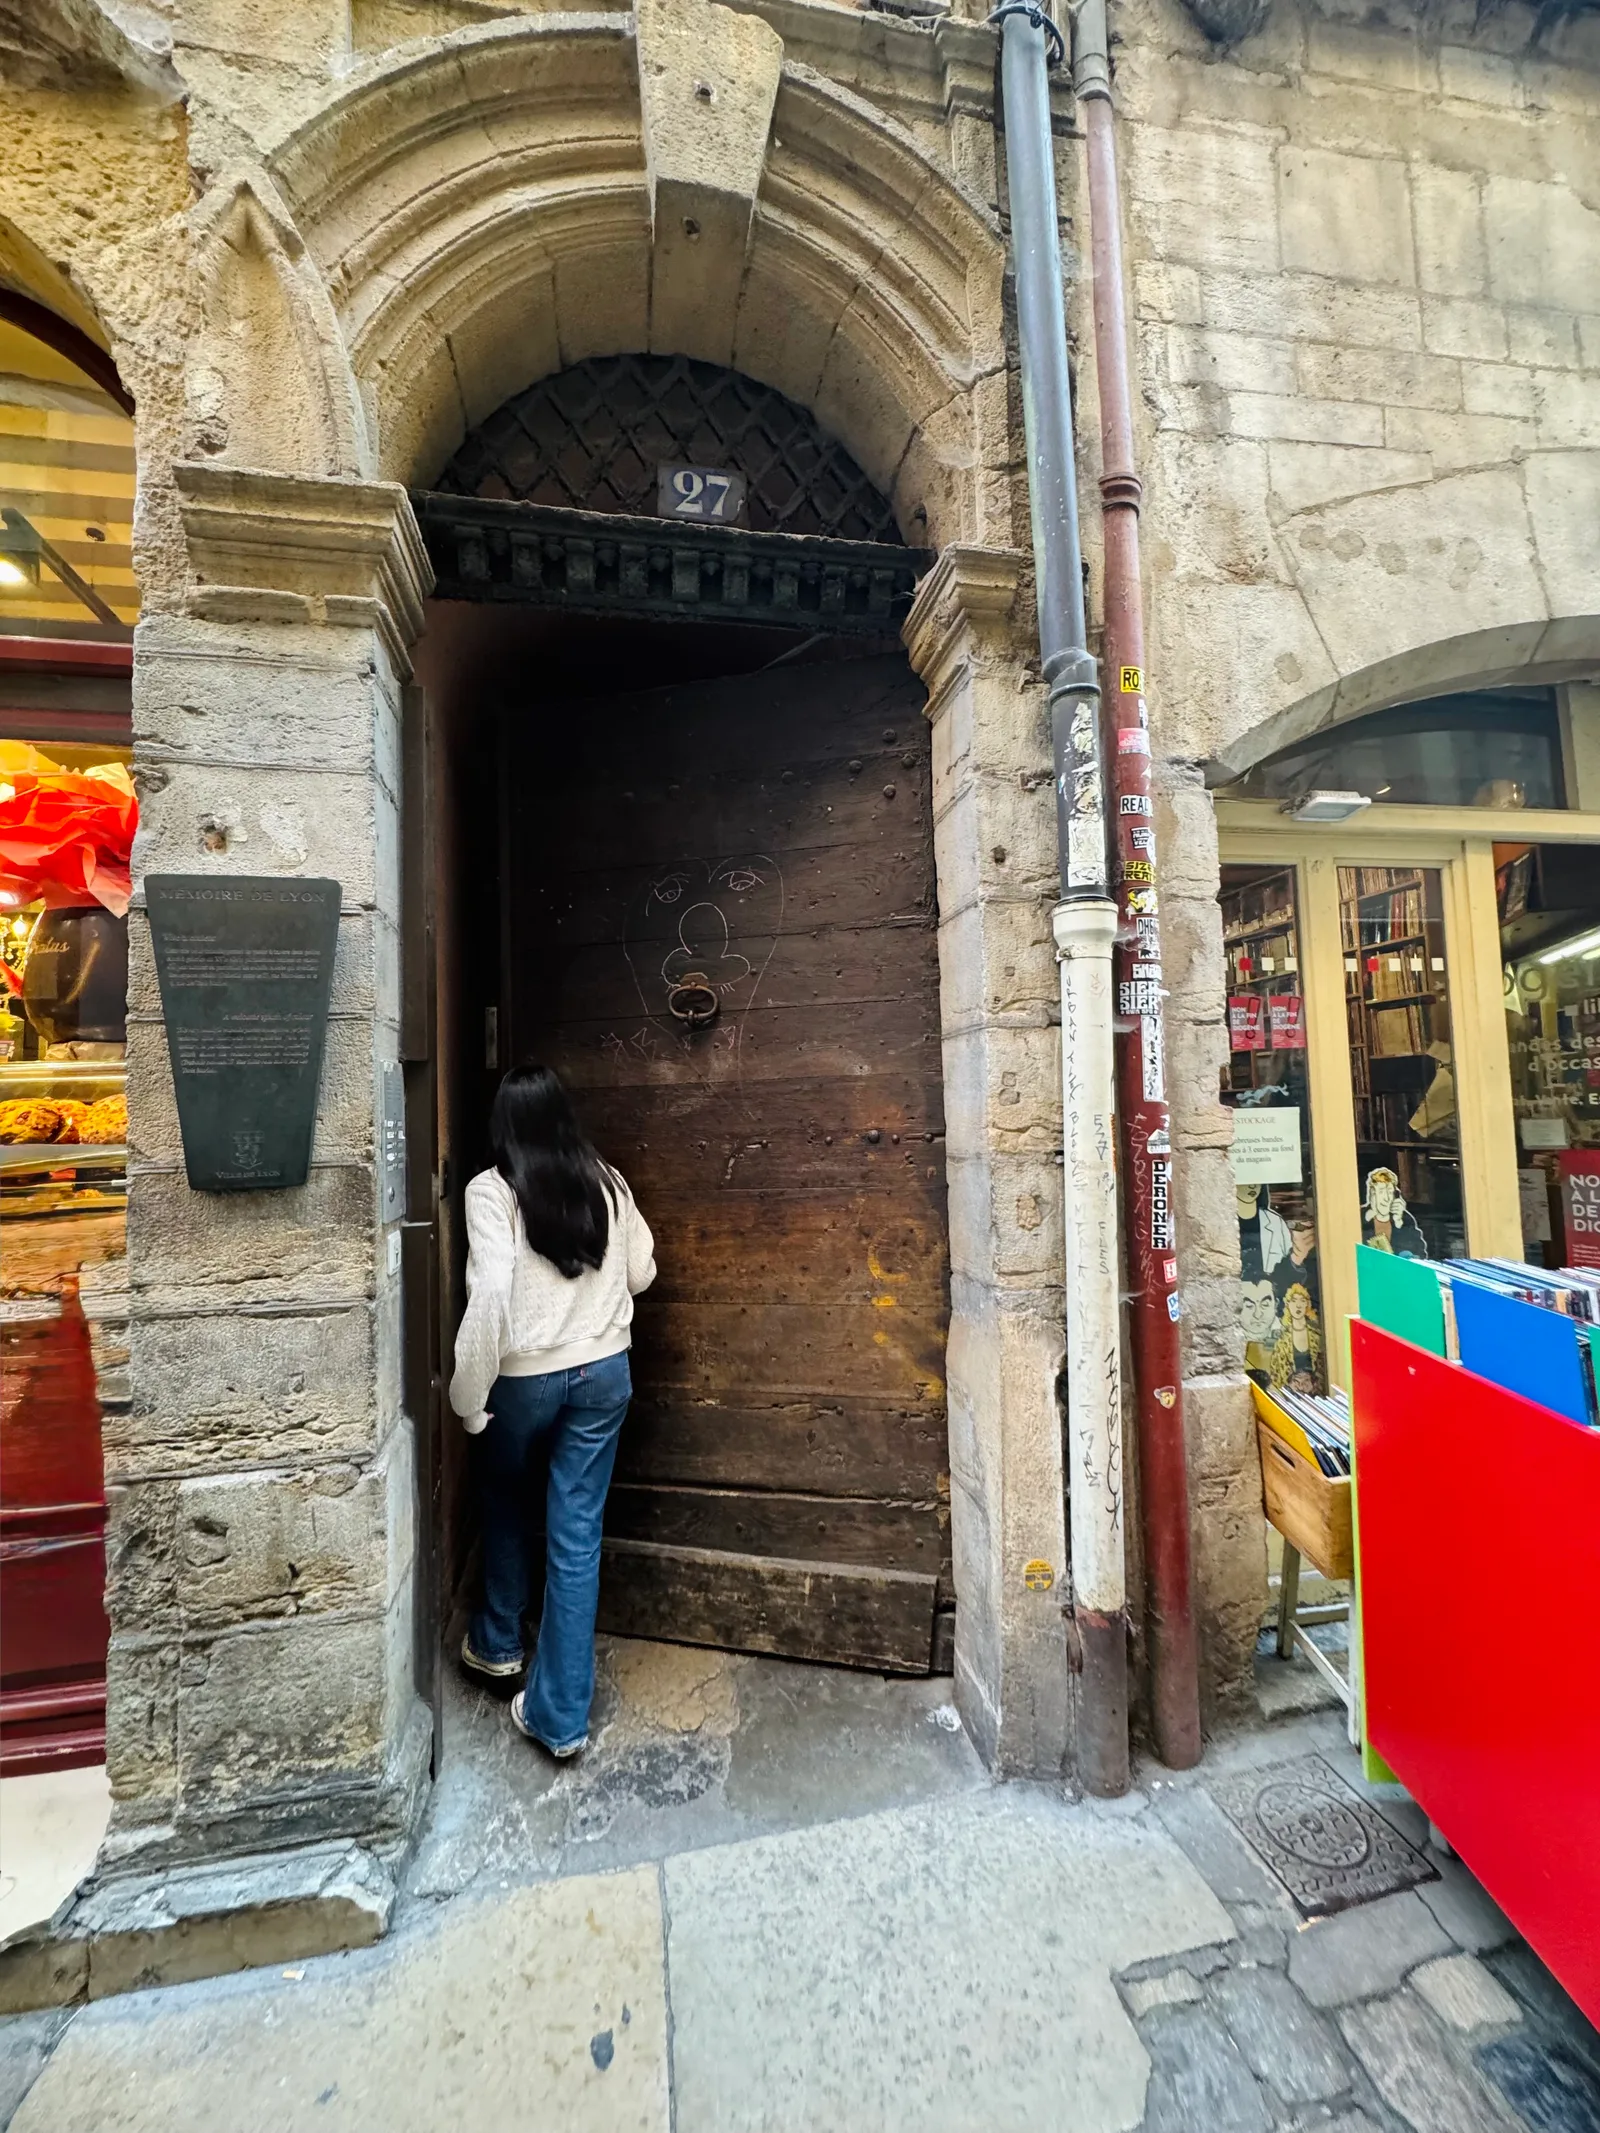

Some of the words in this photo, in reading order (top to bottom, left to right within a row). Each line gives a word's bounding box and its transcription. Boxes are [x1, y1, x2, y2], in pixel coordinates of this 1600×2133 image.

[673, 471, 732, 516] 27
[280, 891, 326, 903] LYON
[1584, 998, 1600, 1014] li
[1588, 1093, 1600, 1105] E
[1572, 1204, 1599, 1218] DE
